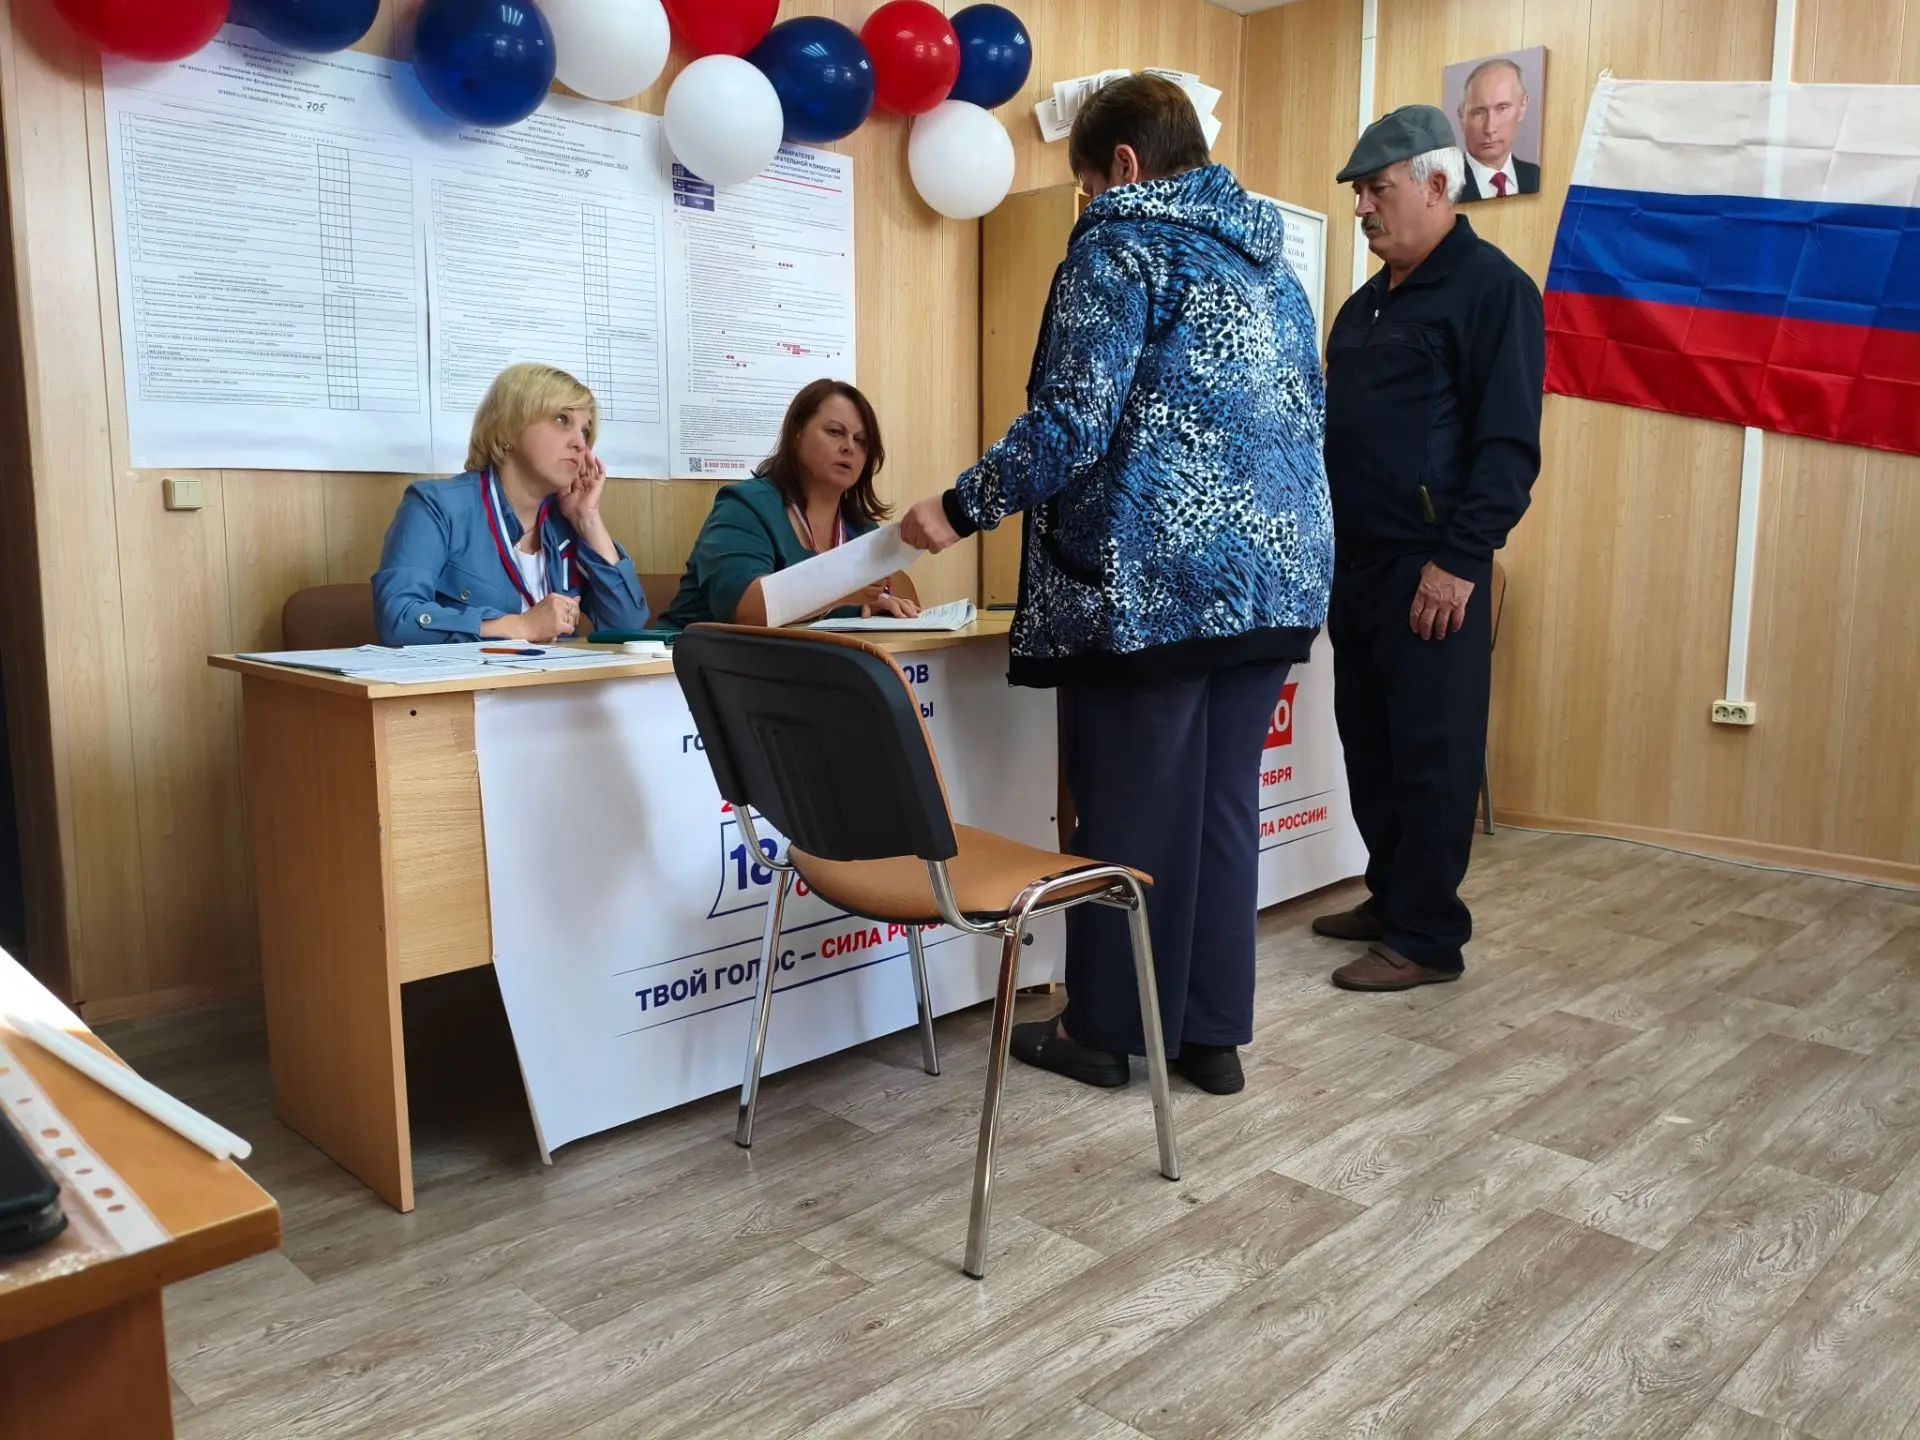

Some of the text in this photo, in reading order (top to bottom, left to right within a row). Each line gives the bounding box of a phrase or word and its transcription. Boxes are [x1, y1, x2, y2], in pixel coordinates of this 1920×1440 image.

[306, 101, 328, 112] 705
[1259, 766, 1292, 788] ЯБРЯ
[1259, 806, 1328, 840] ЛА РОССИИ!
[729, 837, 777, 891] 18
[635, 969, 707, 1012] ТВОЙ
[715, 949, 796, 990] ГОЛС
[820, 926, 883, 960] СИЛА
